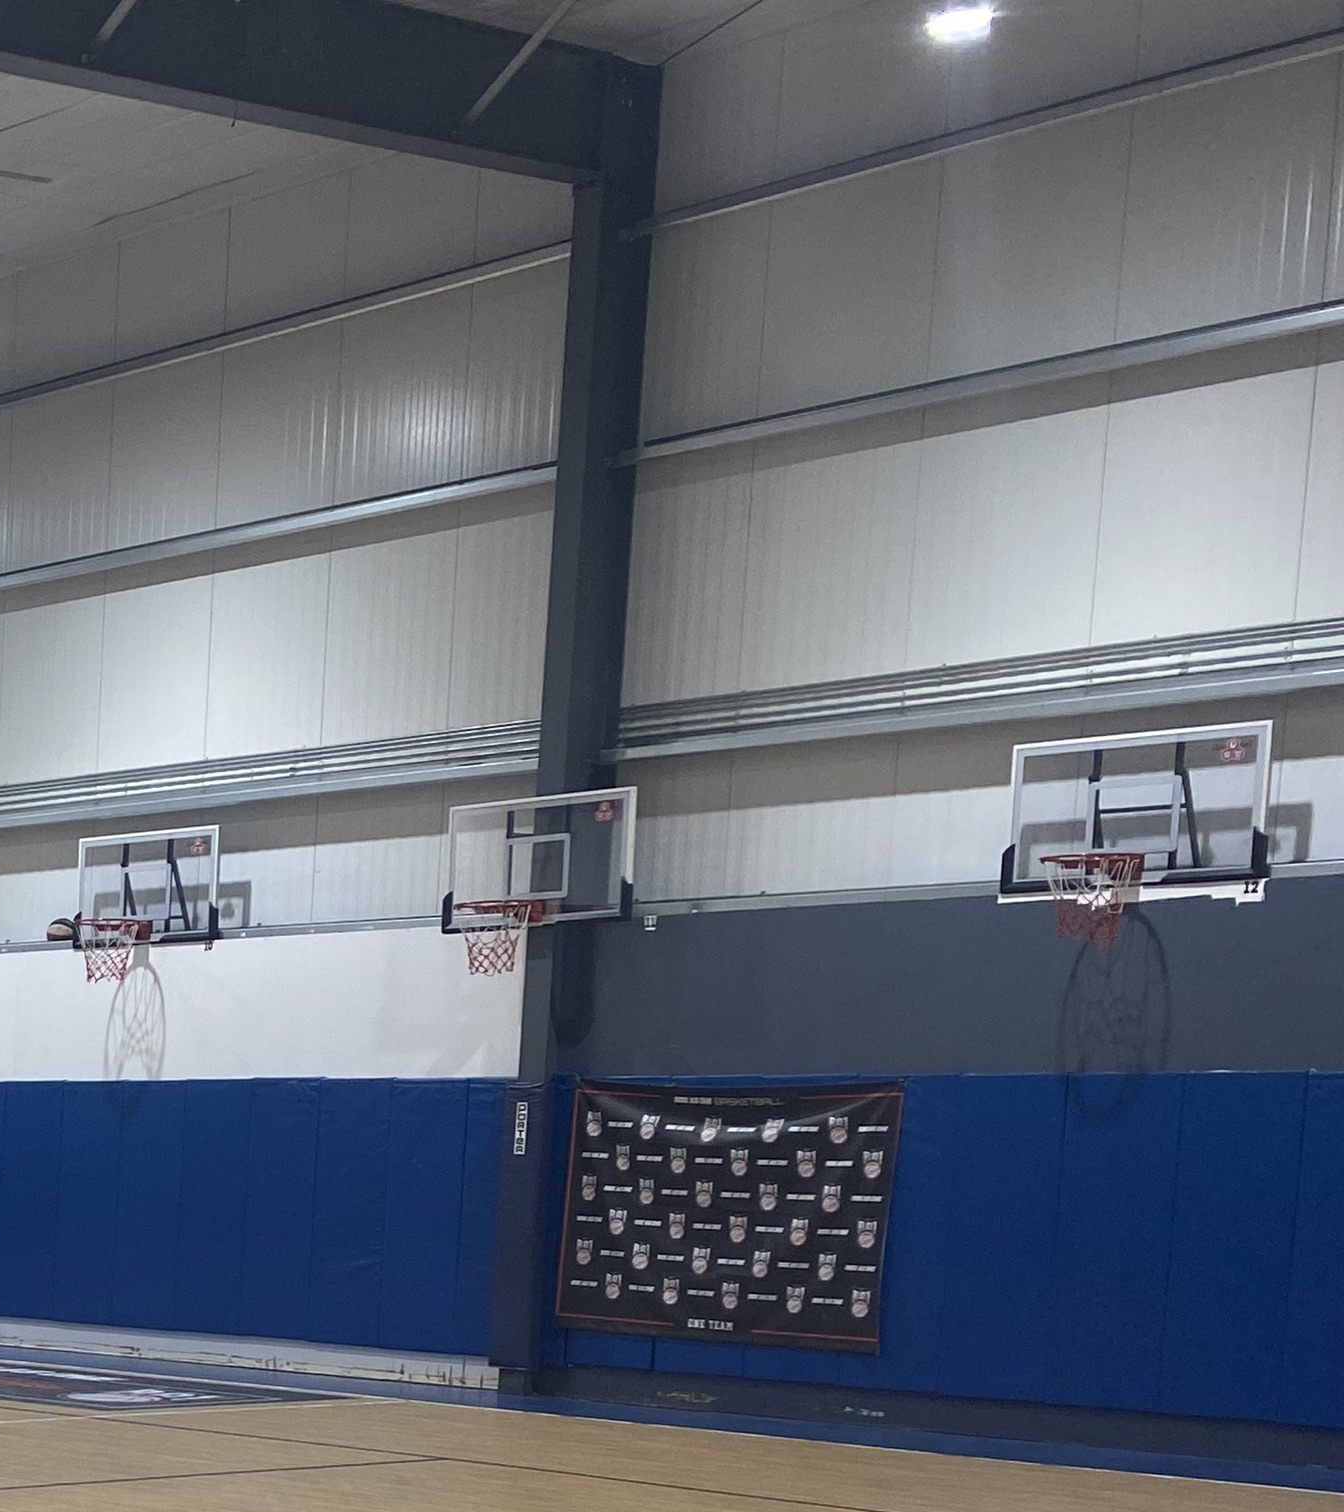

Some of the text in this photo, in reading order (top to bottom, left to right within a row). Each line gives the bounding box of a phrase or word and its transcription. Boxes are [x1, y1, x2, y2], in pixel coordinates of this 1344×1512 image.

[1243, 881, 1259, 893] 12
[515, 1103, 527, 1153] PORTER
[687, 1318, 733, 1331] ONE TEAM
